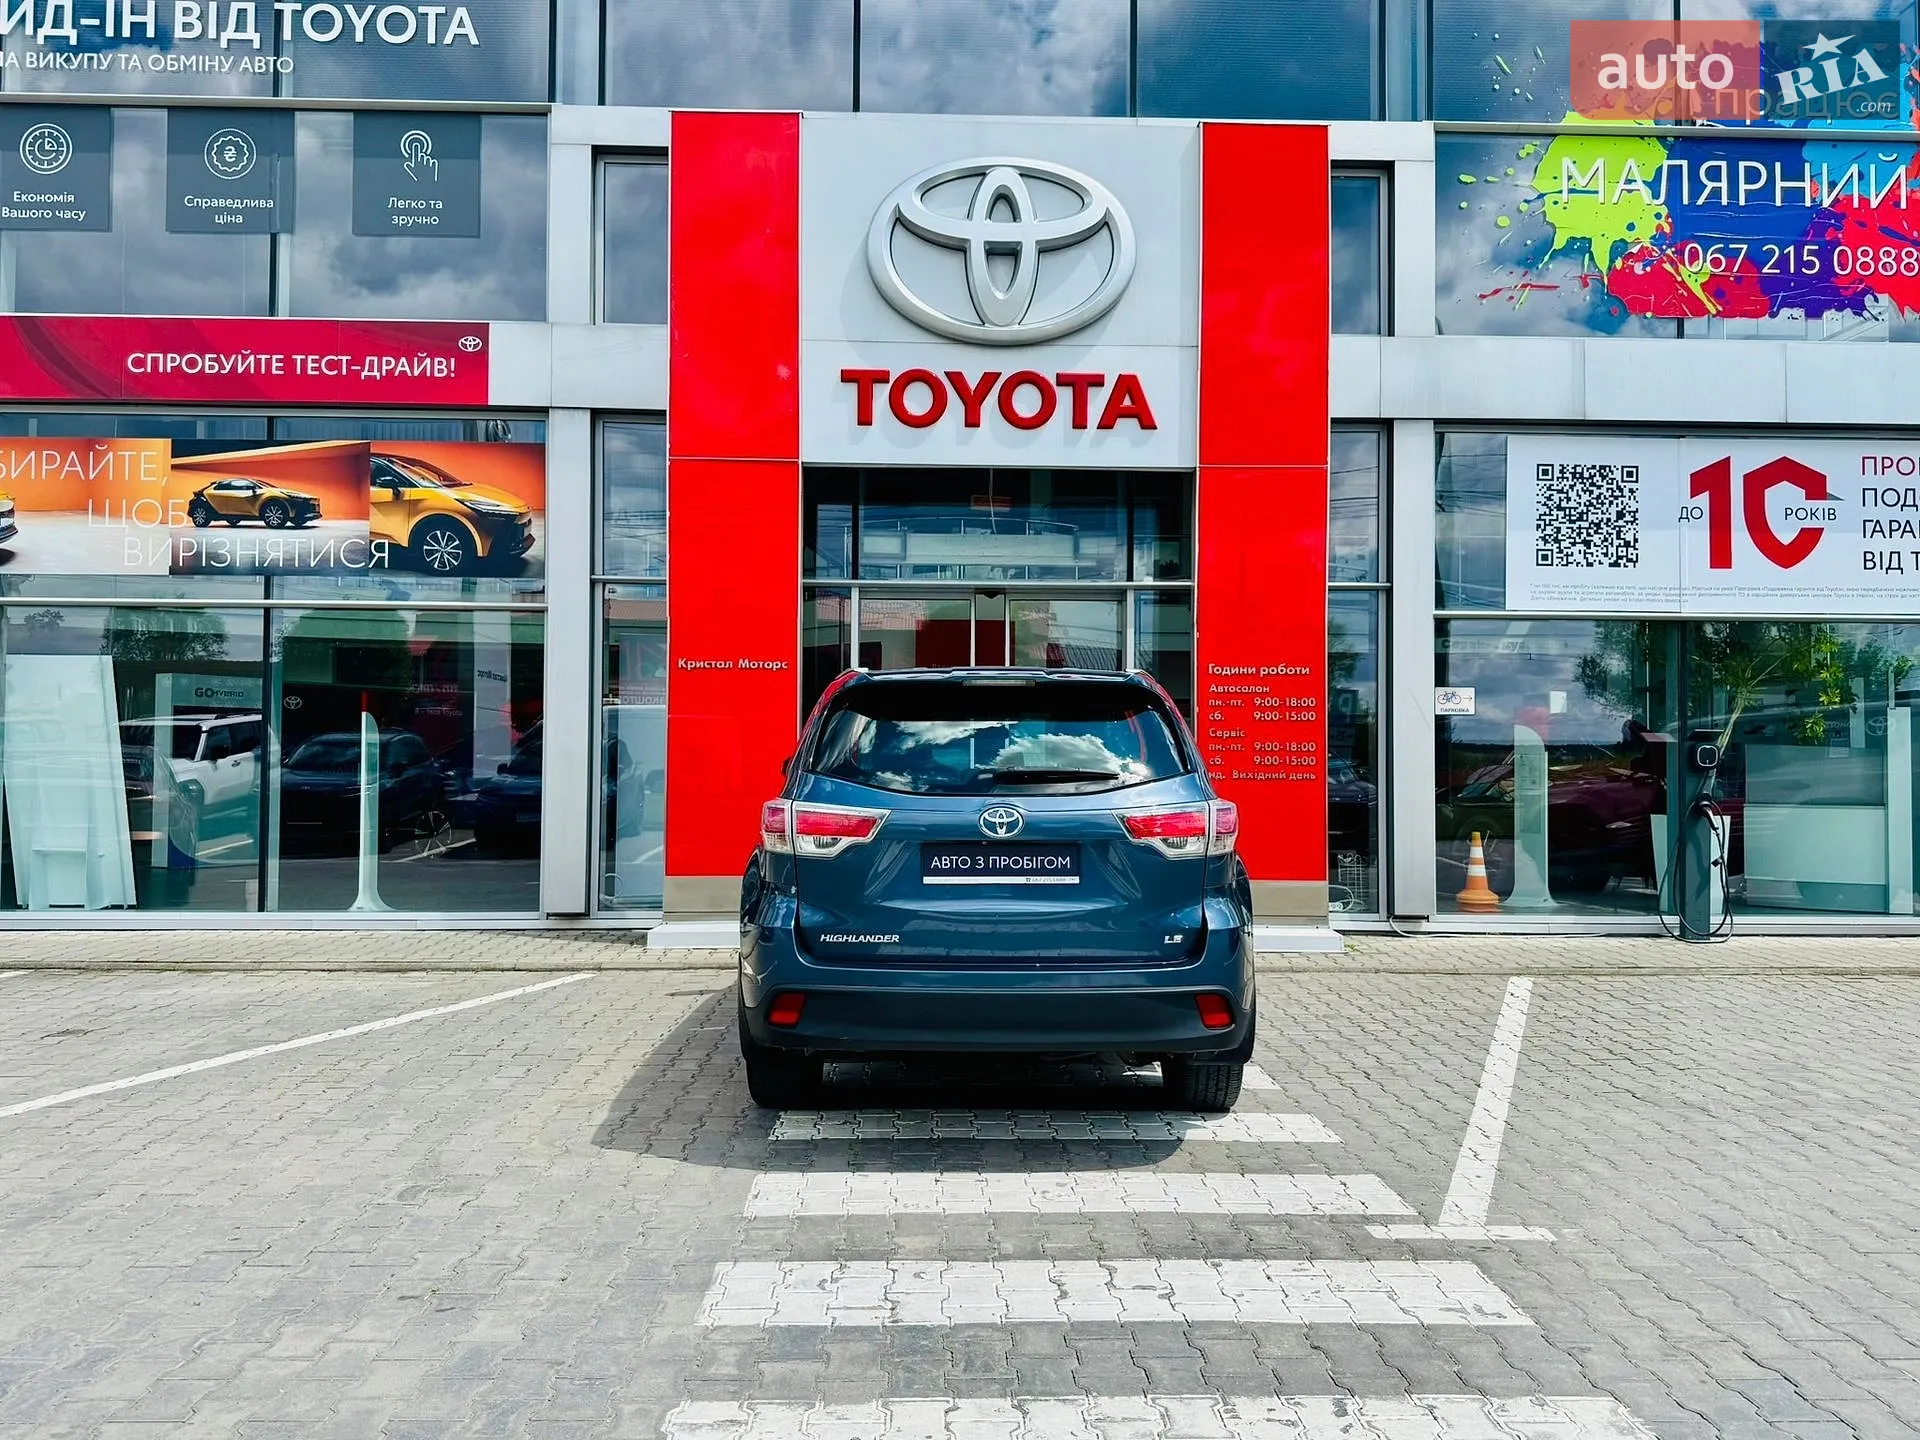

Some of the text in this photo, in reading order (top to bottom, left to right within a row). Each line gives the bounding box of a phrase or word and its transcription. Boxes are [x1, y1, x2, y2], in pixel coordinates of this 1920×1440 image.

[174, 0, 261, 49] ВІД
[274, 3, 480, 46] TOYOTA
[26, 51, 112, 71] ВИКУПУ
[117, 53, 144, 71] ТА
[149, 54, 234, 74] ОБМІНУ
[238, 57, 294, 74] АВТО
[1561, 152, 1909, 210] МАЛЯРНИЙ
[13, 191, 75, 204] Економія
[184, 195, 275, 209] Справедлива
[387, 197, 443, 209] Легко та
[1, 207, 86, 221] Вашого часу
[214, 212, 244, 225] ціна
[391, 215, 440, 227] зручно
[1684, 243, 1920, 277] 067 215 0888
[127, 350, 456, 380] СПРОБУЙТЕ ТЕСТ-ДРАЙВ!
[840, 367, 1158, 431] TOYOTA
[1861, 456, 1920, 476] ПРО
[1862, 487, 1920, 512] ПОД
[88, 498, 188, 530] ЩОБ
[1678, 506, 1704, 523] ДО
[1784, 507, 1837, 521] РОКІВ
[1863, 519, 1920, 539] ГАРА
[123, 537, 389, 569] ВИРІЗНЯТИСЯ
[1863, 550, 1904, 575] ВІД
[678, 657, 789, 672] Кристал Моторс
[1208, 663, 1310, 678] Години роботи
[1208, 684, 1270, 693] Автосалон
[1254, 697, 1317, 707] 9:00-18:00
[1208, 711, 1317, 721] сб. 9:00-15:00
[1209, 727, 1246, 739] Сервіс
[1254, 741, 1317, 752] 9:00-18:00
[1208, 755, 1317, 766] сб. 9:00-15:00
[1232, 769, 1287, 780] Вихідний
[1289, 772, 1317, 781] день
[930, 855, 1071, 869] АВТО З ПРОБІГОМ
[820, 934, 900, 943] HIGHLANDER
